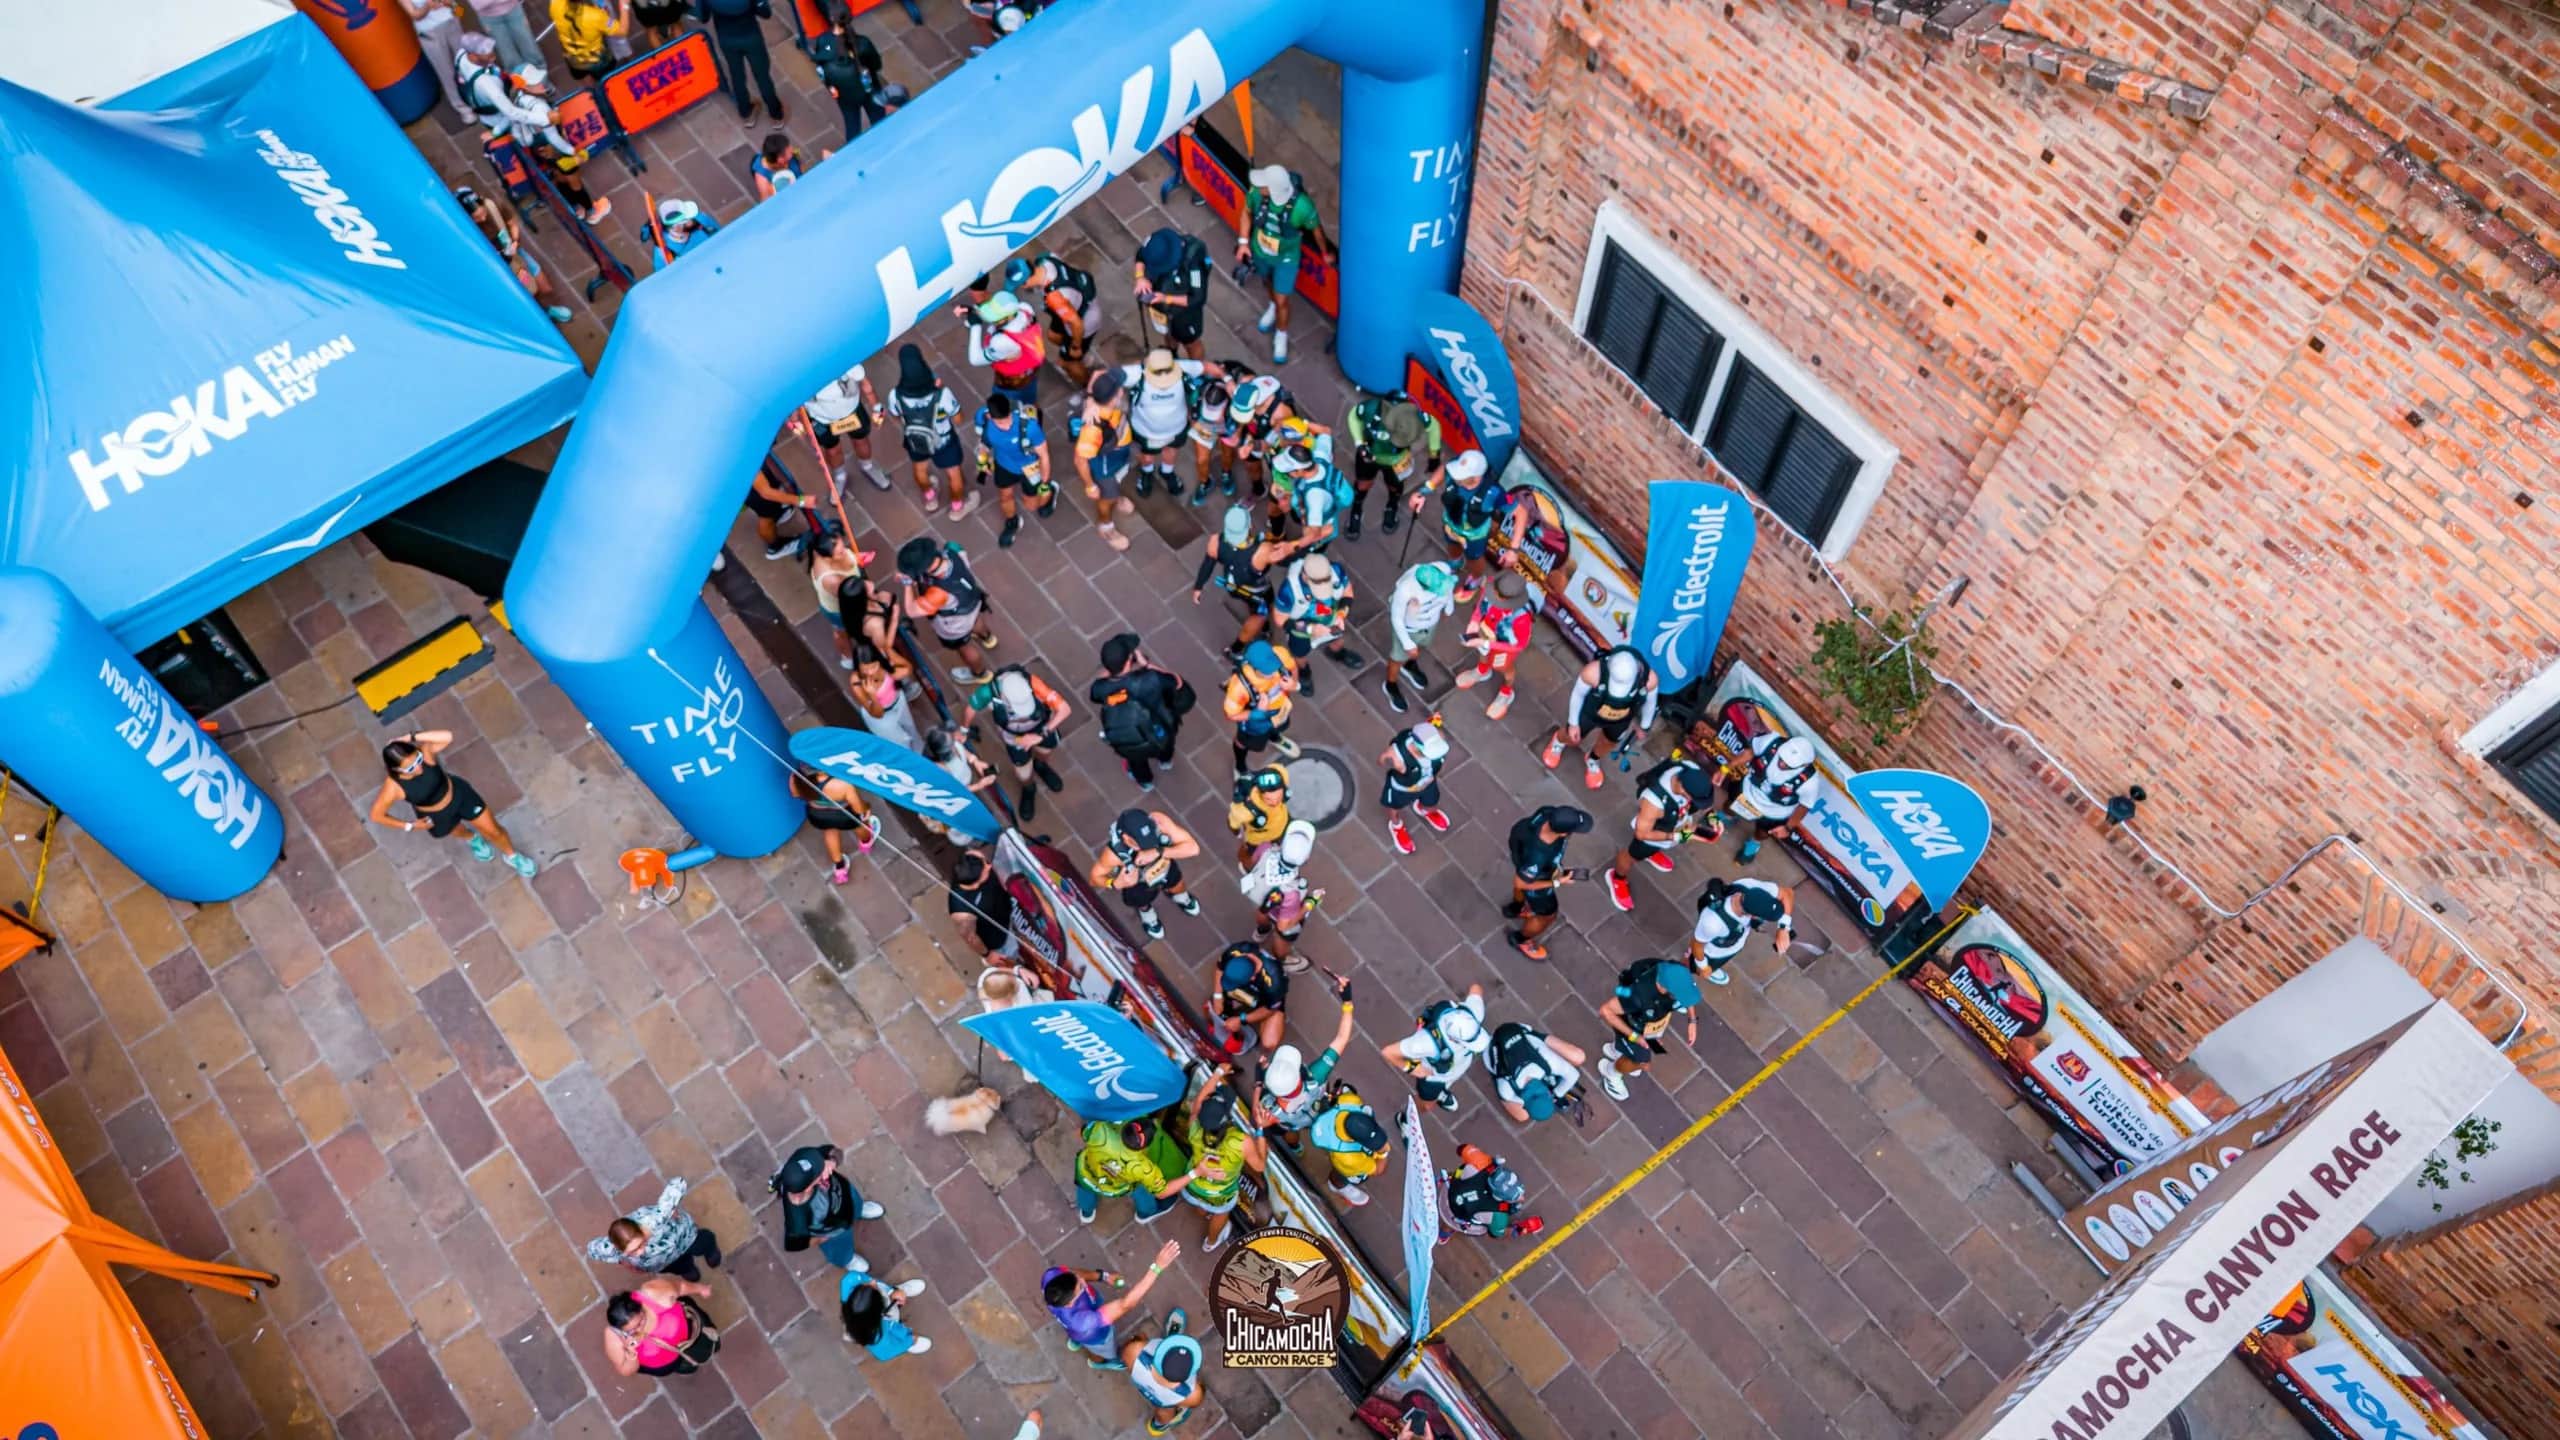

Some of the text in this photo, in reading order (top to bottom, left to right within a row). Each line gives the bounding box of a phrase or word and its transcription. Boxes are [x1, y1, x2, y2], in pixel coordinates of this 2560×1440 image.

[626, 49, 691, 89] PEOPLE
[631, 61, 694, 101] PLAYS
[277, 160, 408, 270] HOKA
[875, 28, 1226, 345] HOKA
[1408, 203, 1464, 253] FLY
[254, 340, 292, 373] FLY
[267, 334, 356, 391] HUMAN
[1430, 328, 1512, 439] HOKA
[279, 374, 318, 409] FLY
[69, 366, 284, 512] HOKA
[1673, 500, 1728, 612] Electrolit
[99, 657, 157, 729] HUMAN
[630, 655, 732, 744] TIME
[696, 687, 743, 747] TO
[115, 715, 149, 750] FLY
[672, 732, 736, 783] FLY
[146, 697, 262, 851] HOKA
[820, 751, 972, 816] HOKA
[1808, 798, 1893, 888] HOKA
[1869, 790, 1965, 860] HOKA
[1949, 964, 2024, 1040] CHICAMOCHA
[1031, 1009, 1126, 1071] Electrolit
[2088, 1096, 2138, 1148] Turismo
[2094, 1091, 2156, 1151] Cultura y
[2100, 1084, 2164, 1148] Instituto de
[2037, 1110, 2402, 1440] AMOCHA CANYON RACE
